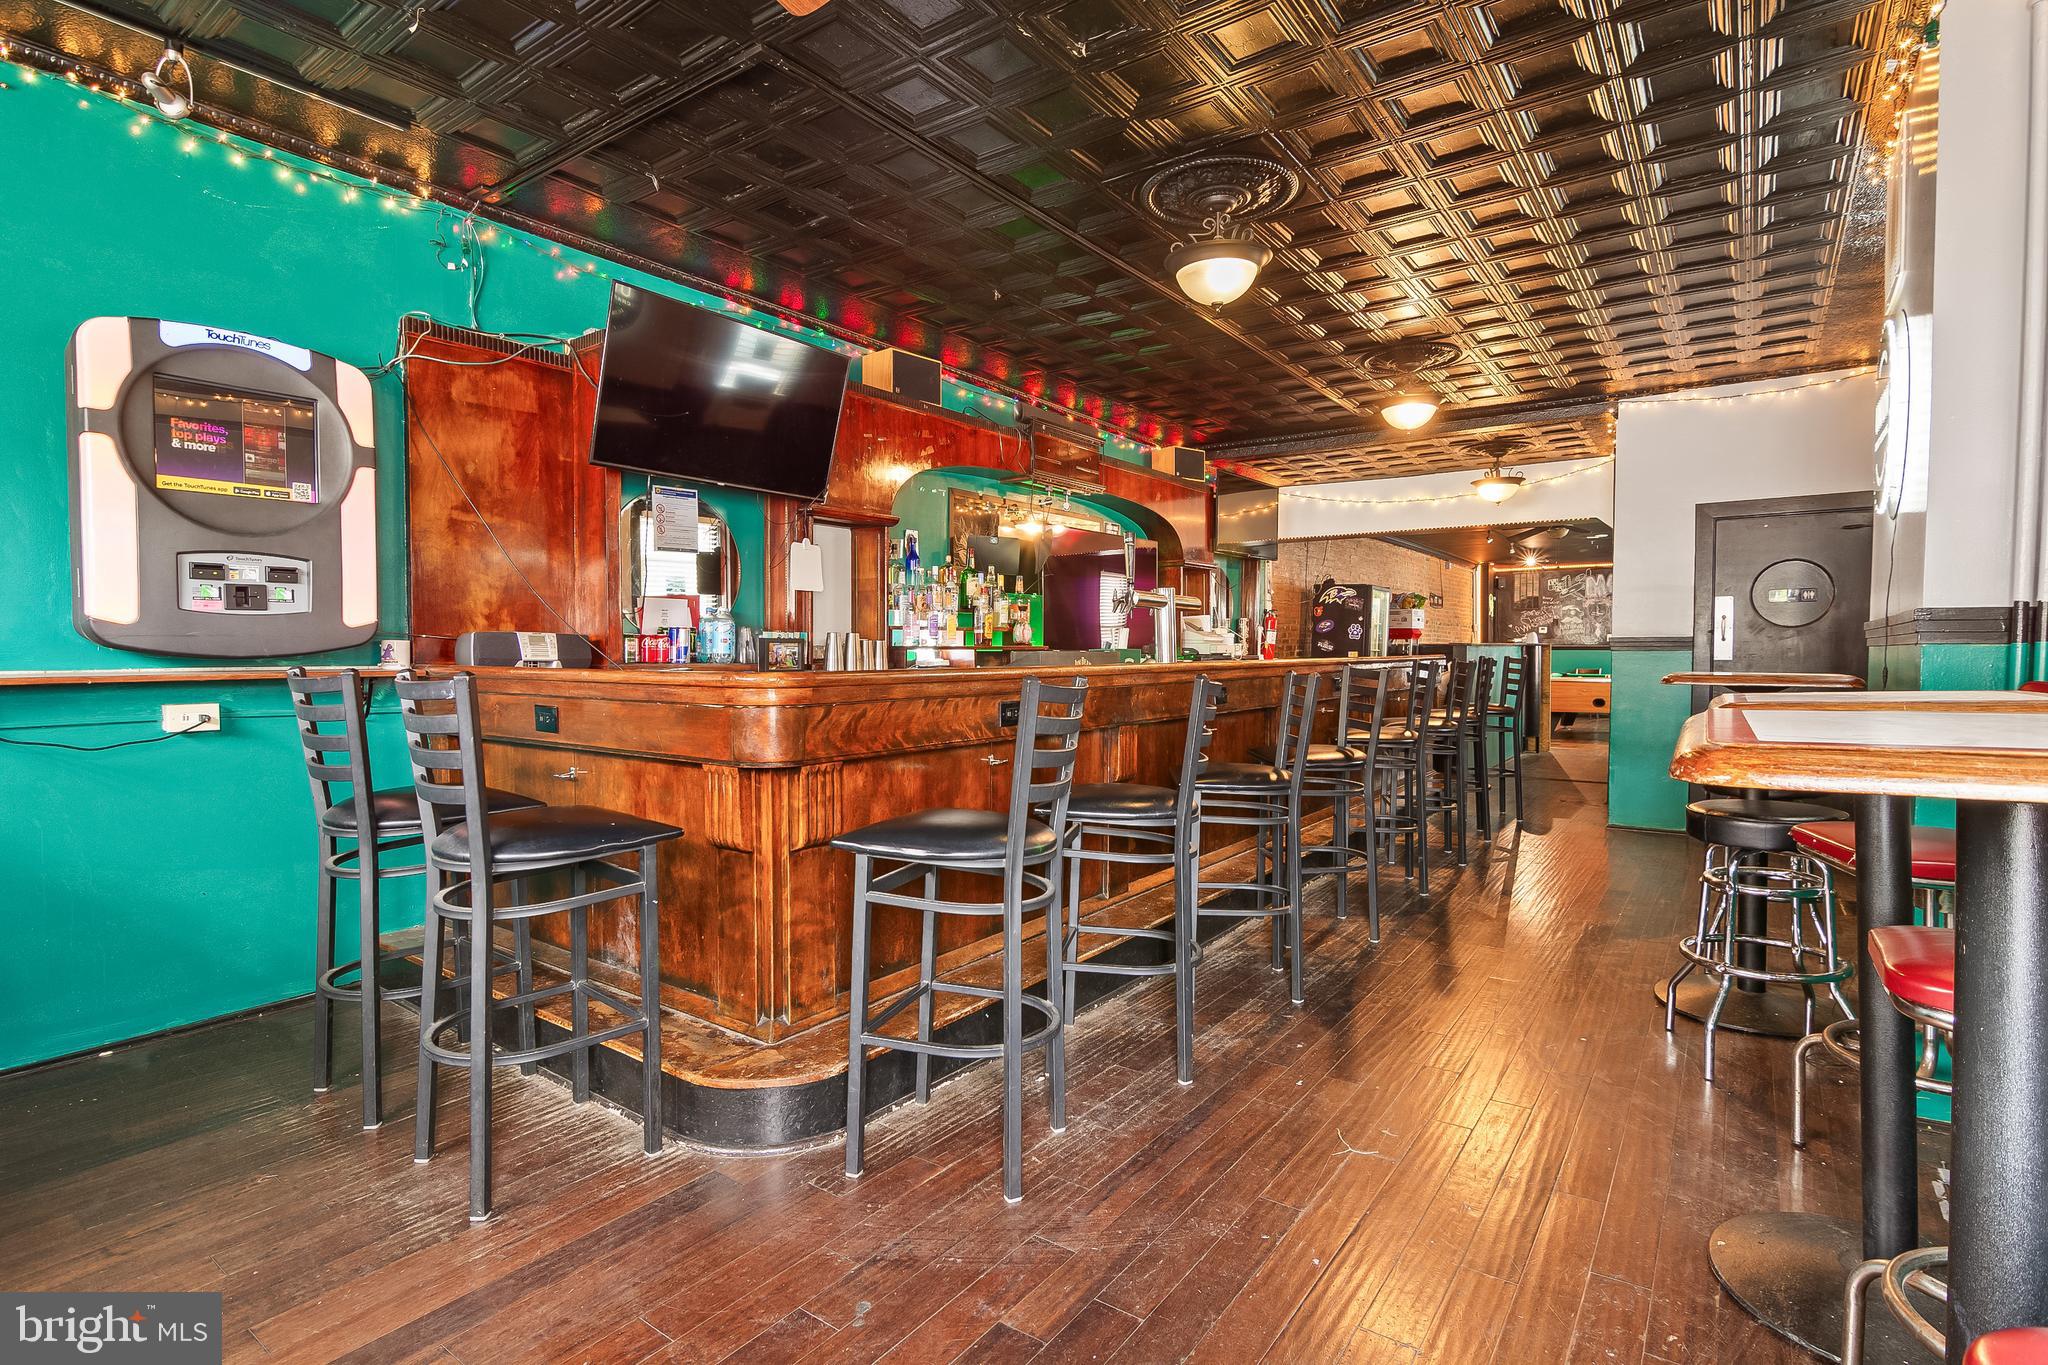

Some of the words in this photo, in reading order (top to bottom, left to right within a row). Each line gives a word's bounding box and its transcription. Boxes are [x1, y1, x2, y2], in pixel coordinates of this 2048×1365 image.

[205, 328, 271, 350] TouchTunes
[170, 417, 229, 436] Favorites,
[171, 428, 192, 441] top
[195, 430, 227, 445] plays
[171, 438, 182, 448] &
[184, 442, 217, 452] more
[184, 482, 217, 491] TouchTunes
